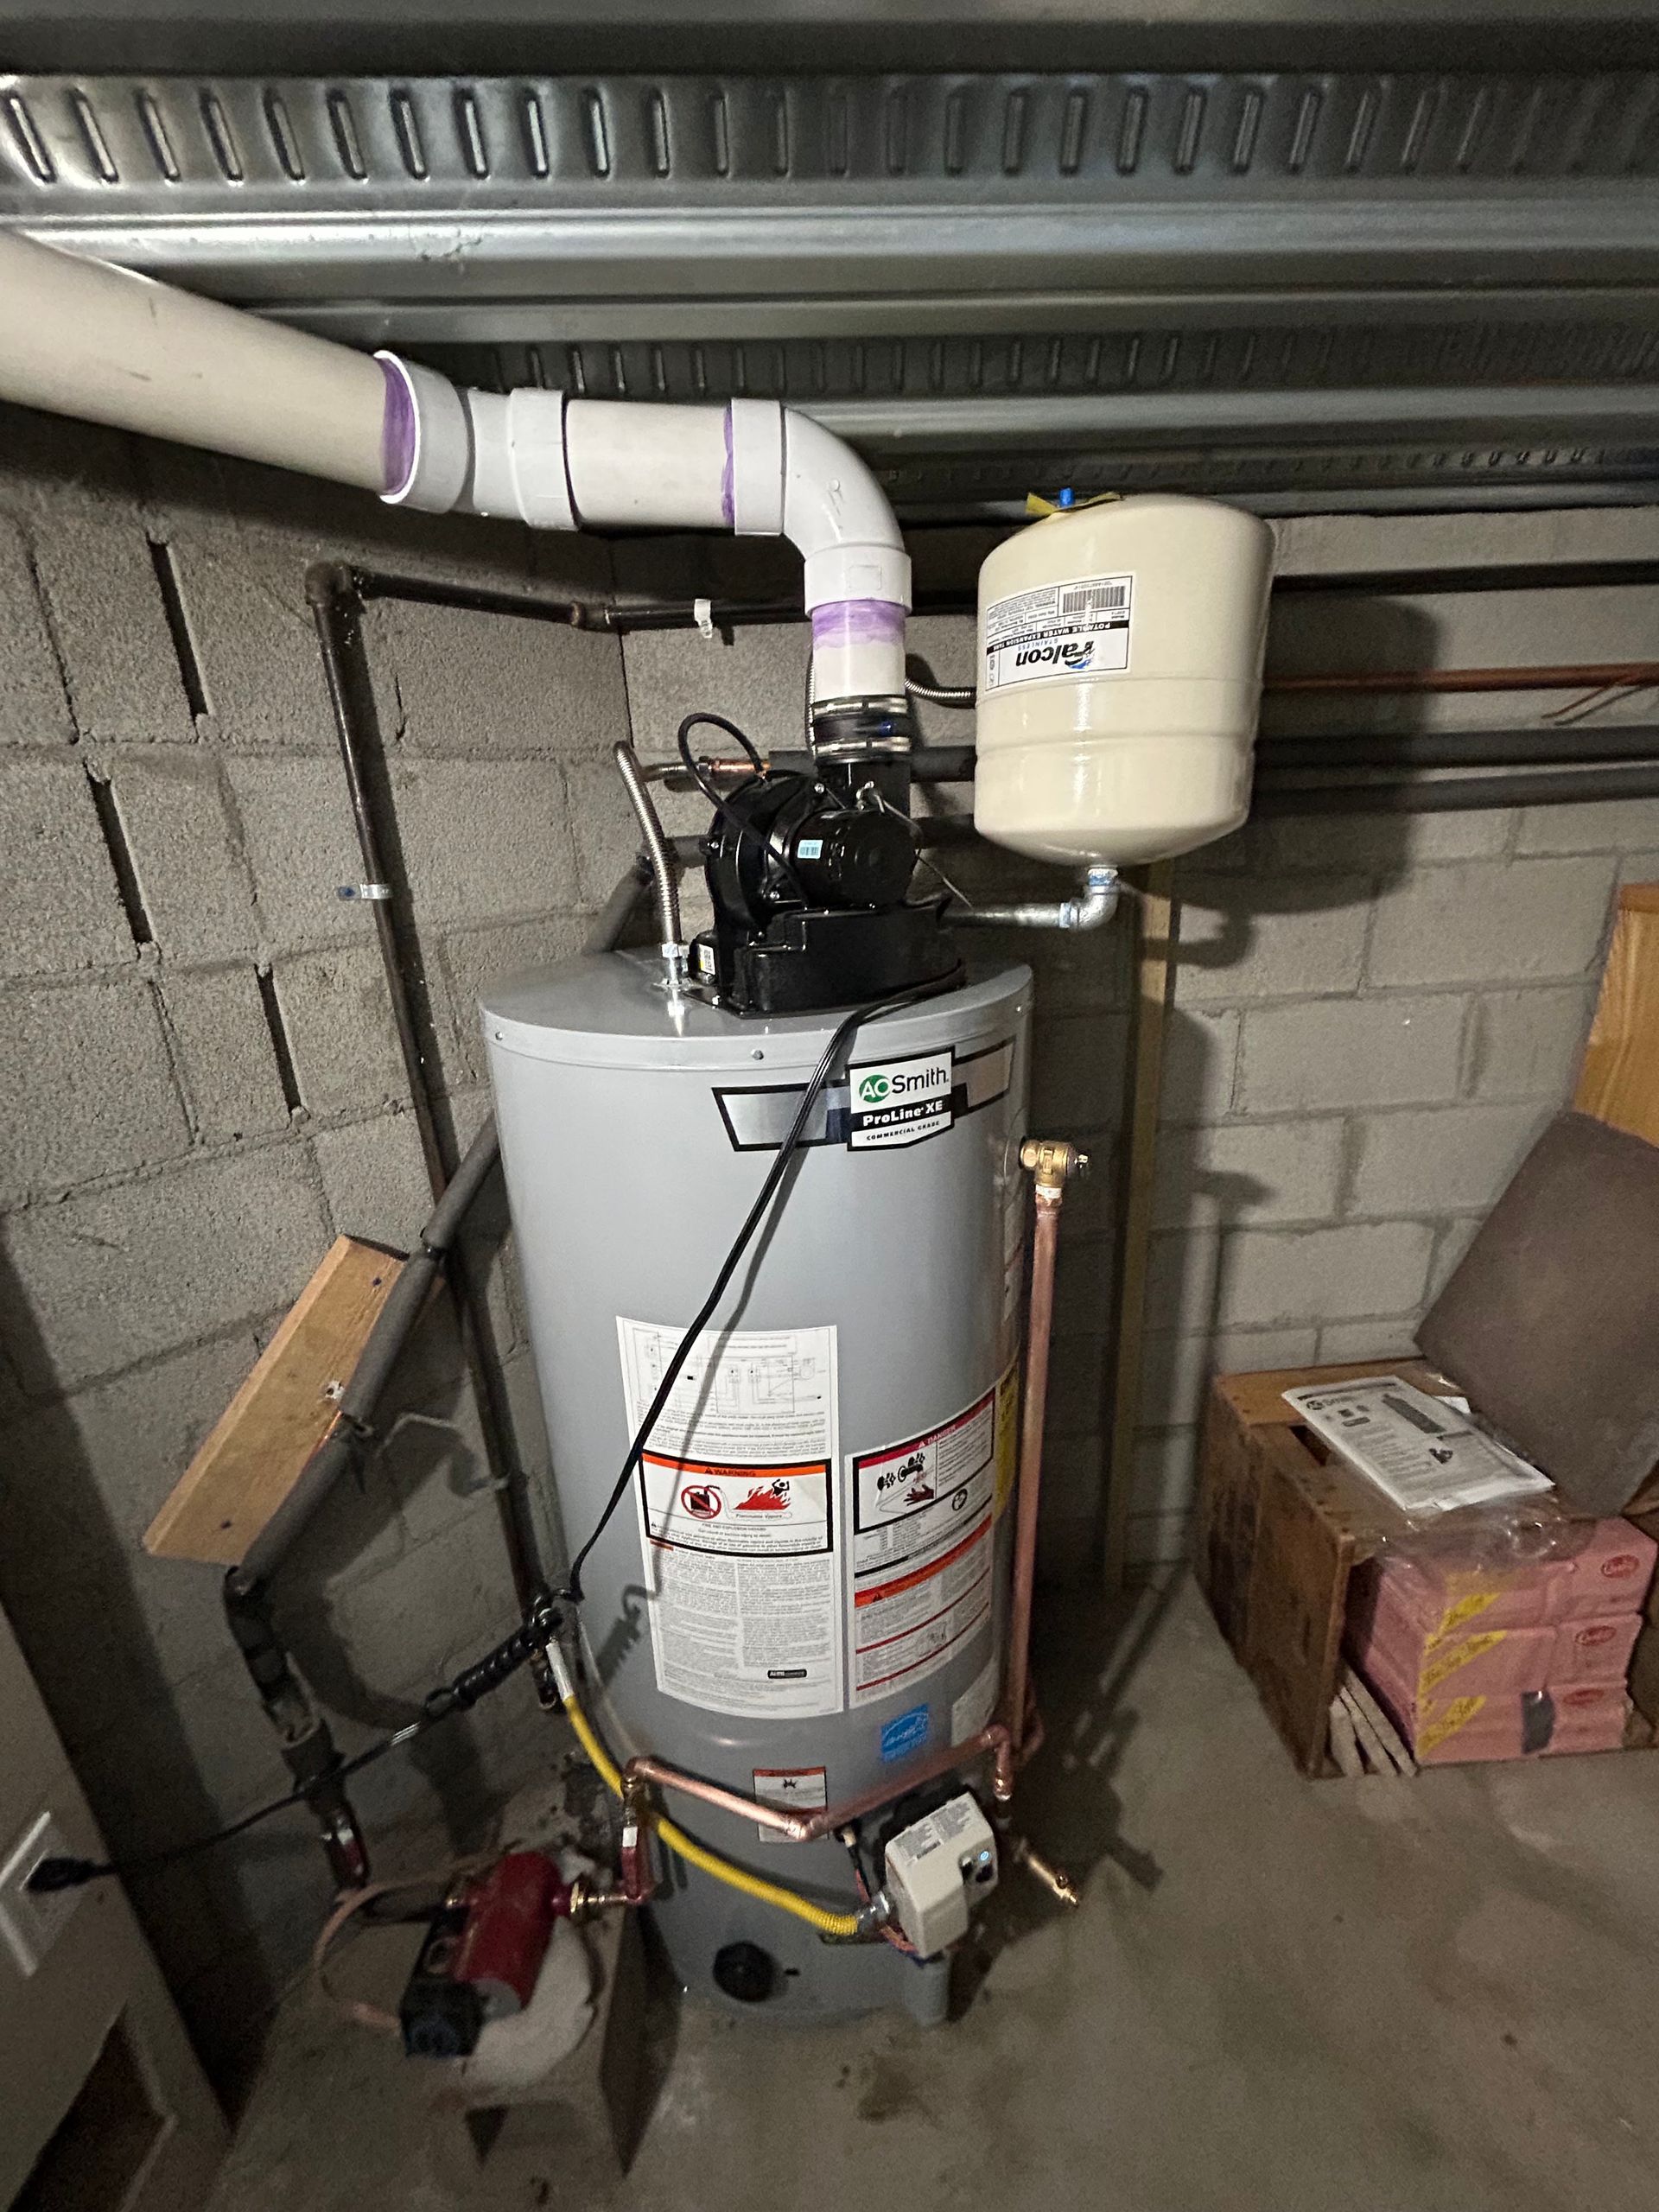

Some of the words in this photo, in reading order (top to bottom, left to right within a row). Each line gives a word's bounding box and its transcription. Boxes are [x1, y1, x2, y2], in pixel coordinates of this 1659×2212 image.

[1044, 626, 1071, 636] WATER
[1071, 622, 1111, 632] POTABLE
[1006, 631, 1042, 646] EXPANSION
[1017, 638, 1058, 652] STAINLESS
[1015, 640, 1096, 669] Falcon
[892, 1067, 947, 1094] Smith
[863, 1106, 924, 1127] ProLine
[925, 1099, 943, 1114] XE
[866, 1127, 916, 1141] COMMERCIAL
[917, 1120, 940, 1131] GRADE
[714, 1468, 757, 1477] WARNING
